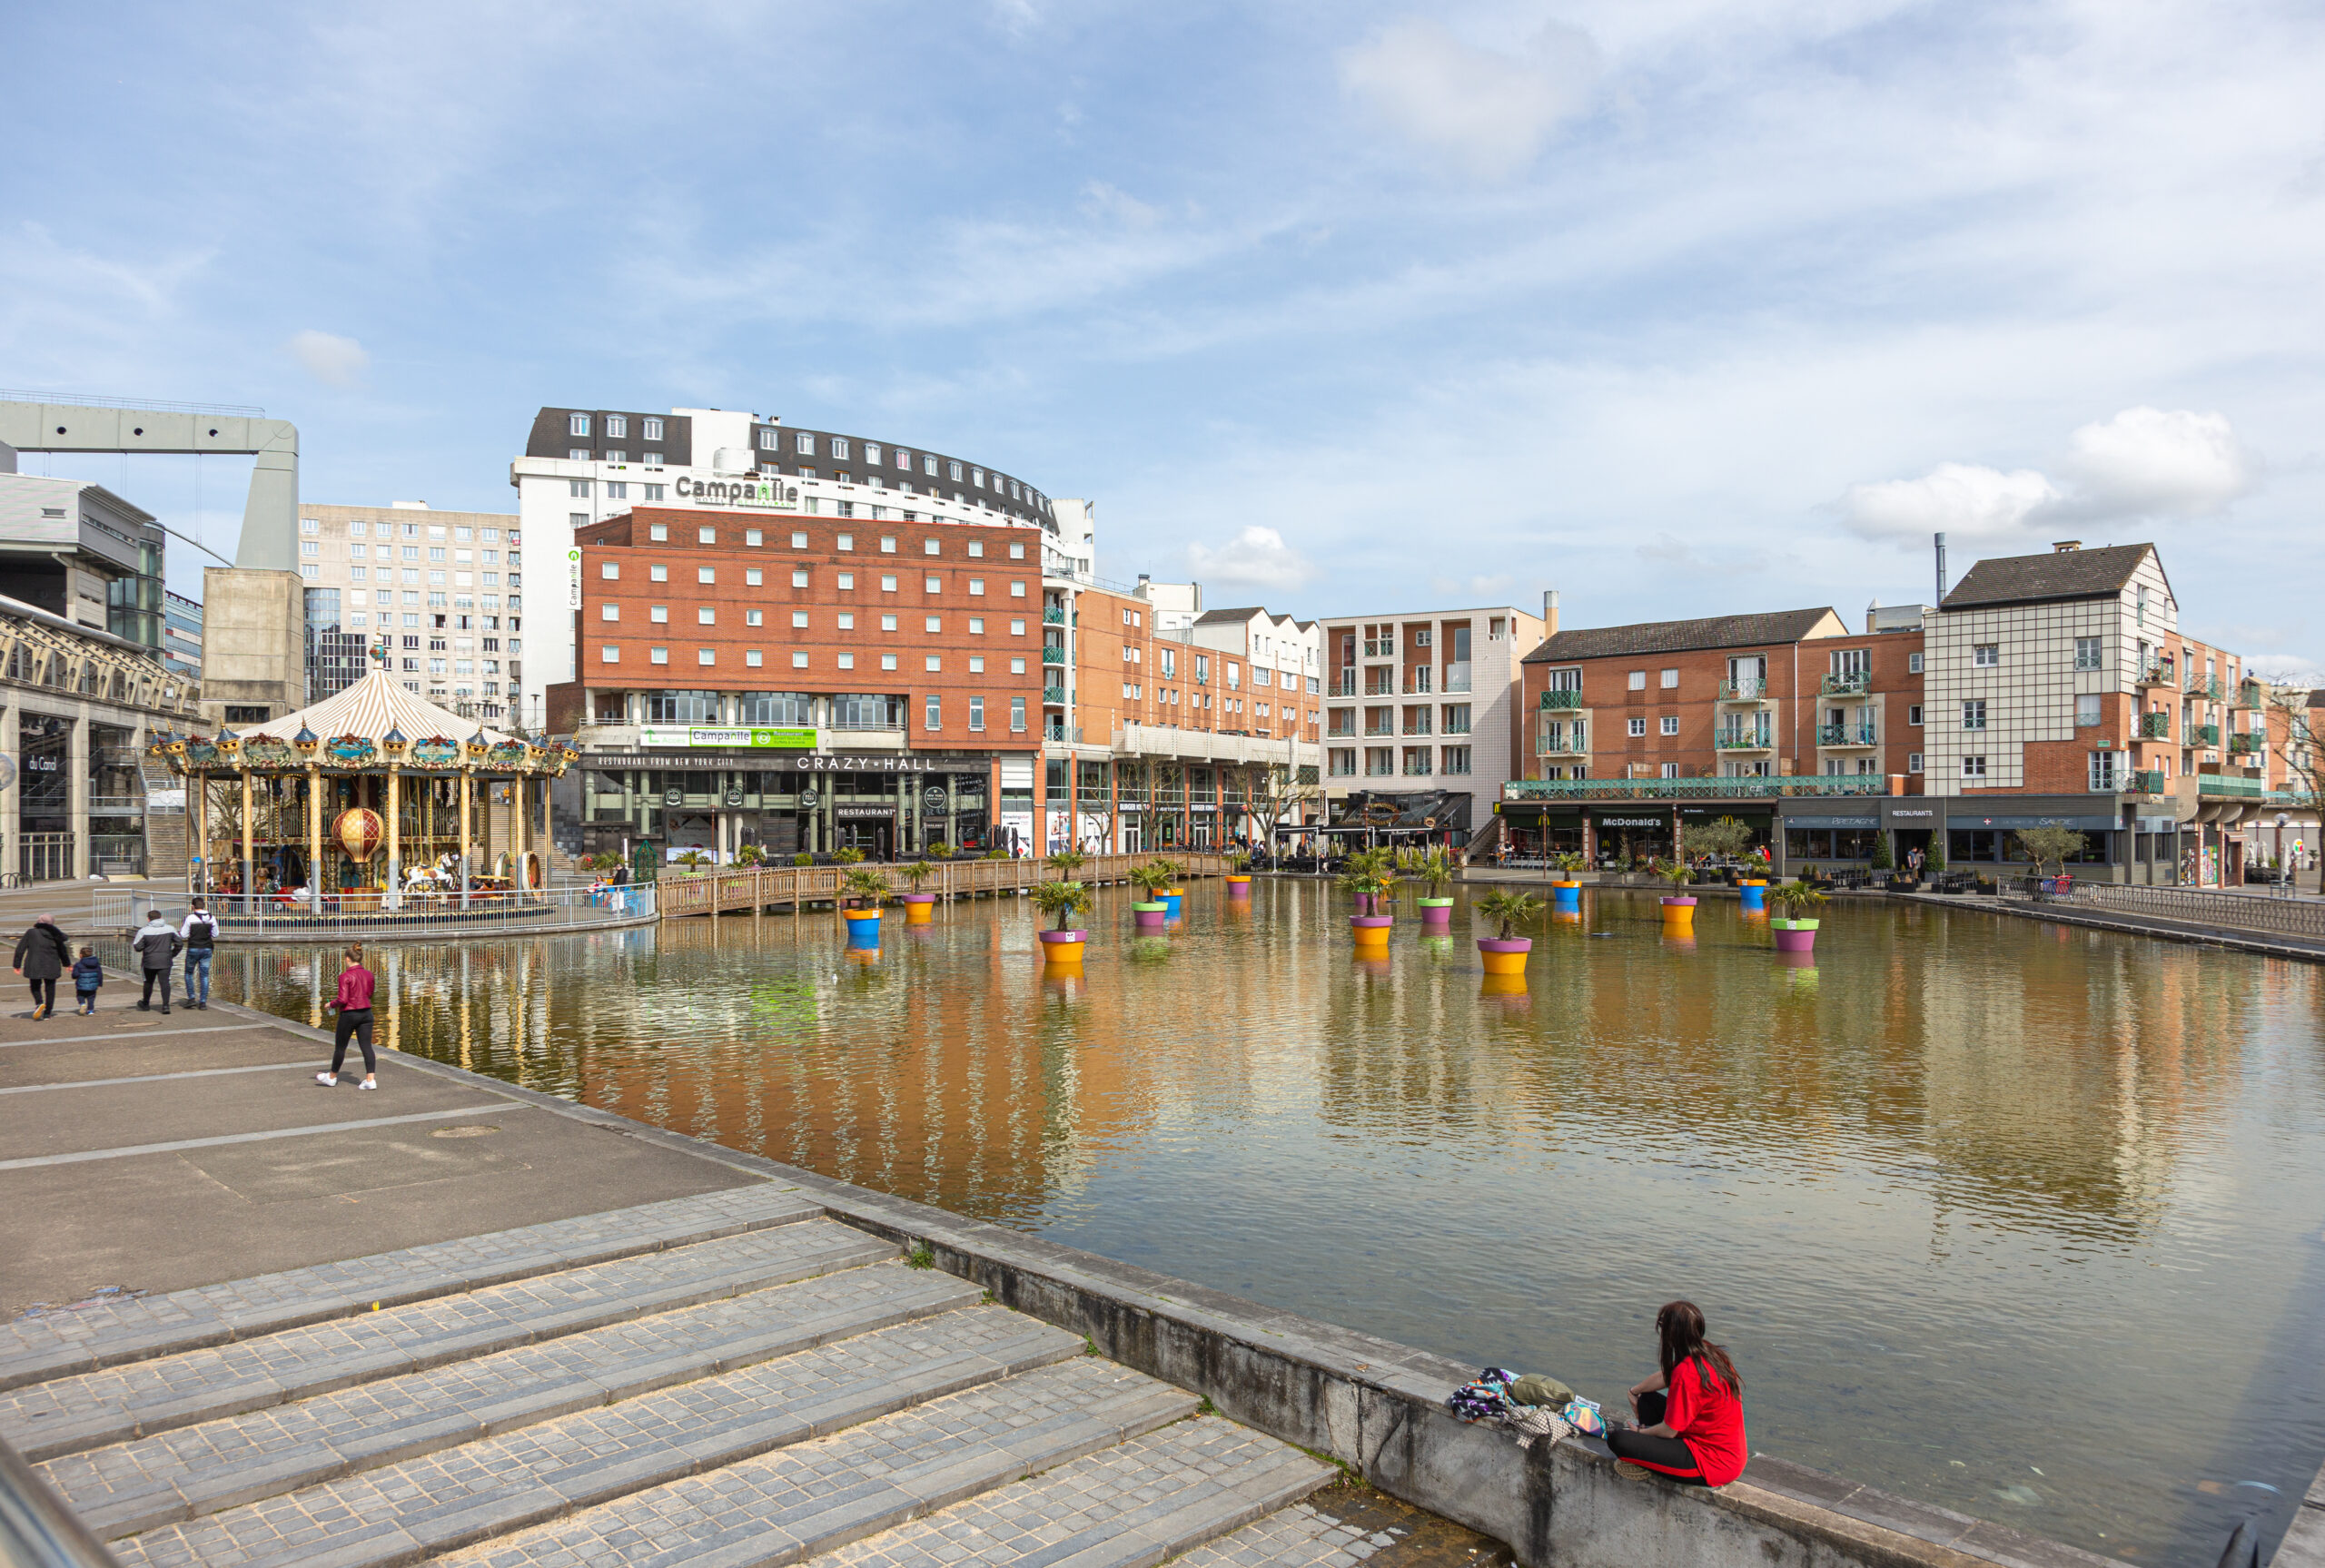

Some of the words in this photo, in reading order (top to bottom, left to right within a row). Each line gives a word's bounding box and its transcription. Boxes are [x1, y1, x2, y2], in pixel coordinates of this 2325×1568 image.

[676, 476, 798, 506] Campanile
[569, 564, 579, 606] Campanile
[693, 730, 749, 743] Campanile
[29, 754, 38, 770] du
[39, 756, 57, 771] Canal
[598, 757, 646, 765] RESTAURANT
[650, 757, 670, 765] FROM
[675, 757, 689, 766] NEW
[695, 758, 713, 766] YORK
[717, 758, 734, 766] CITY
[797, 757, 868, 770] CRAZY
[884, 758, 935, 771] HALL
[838, 808, 893, 816] RESTAURANT
[1602, 817, 1661, 826] McDonald's
